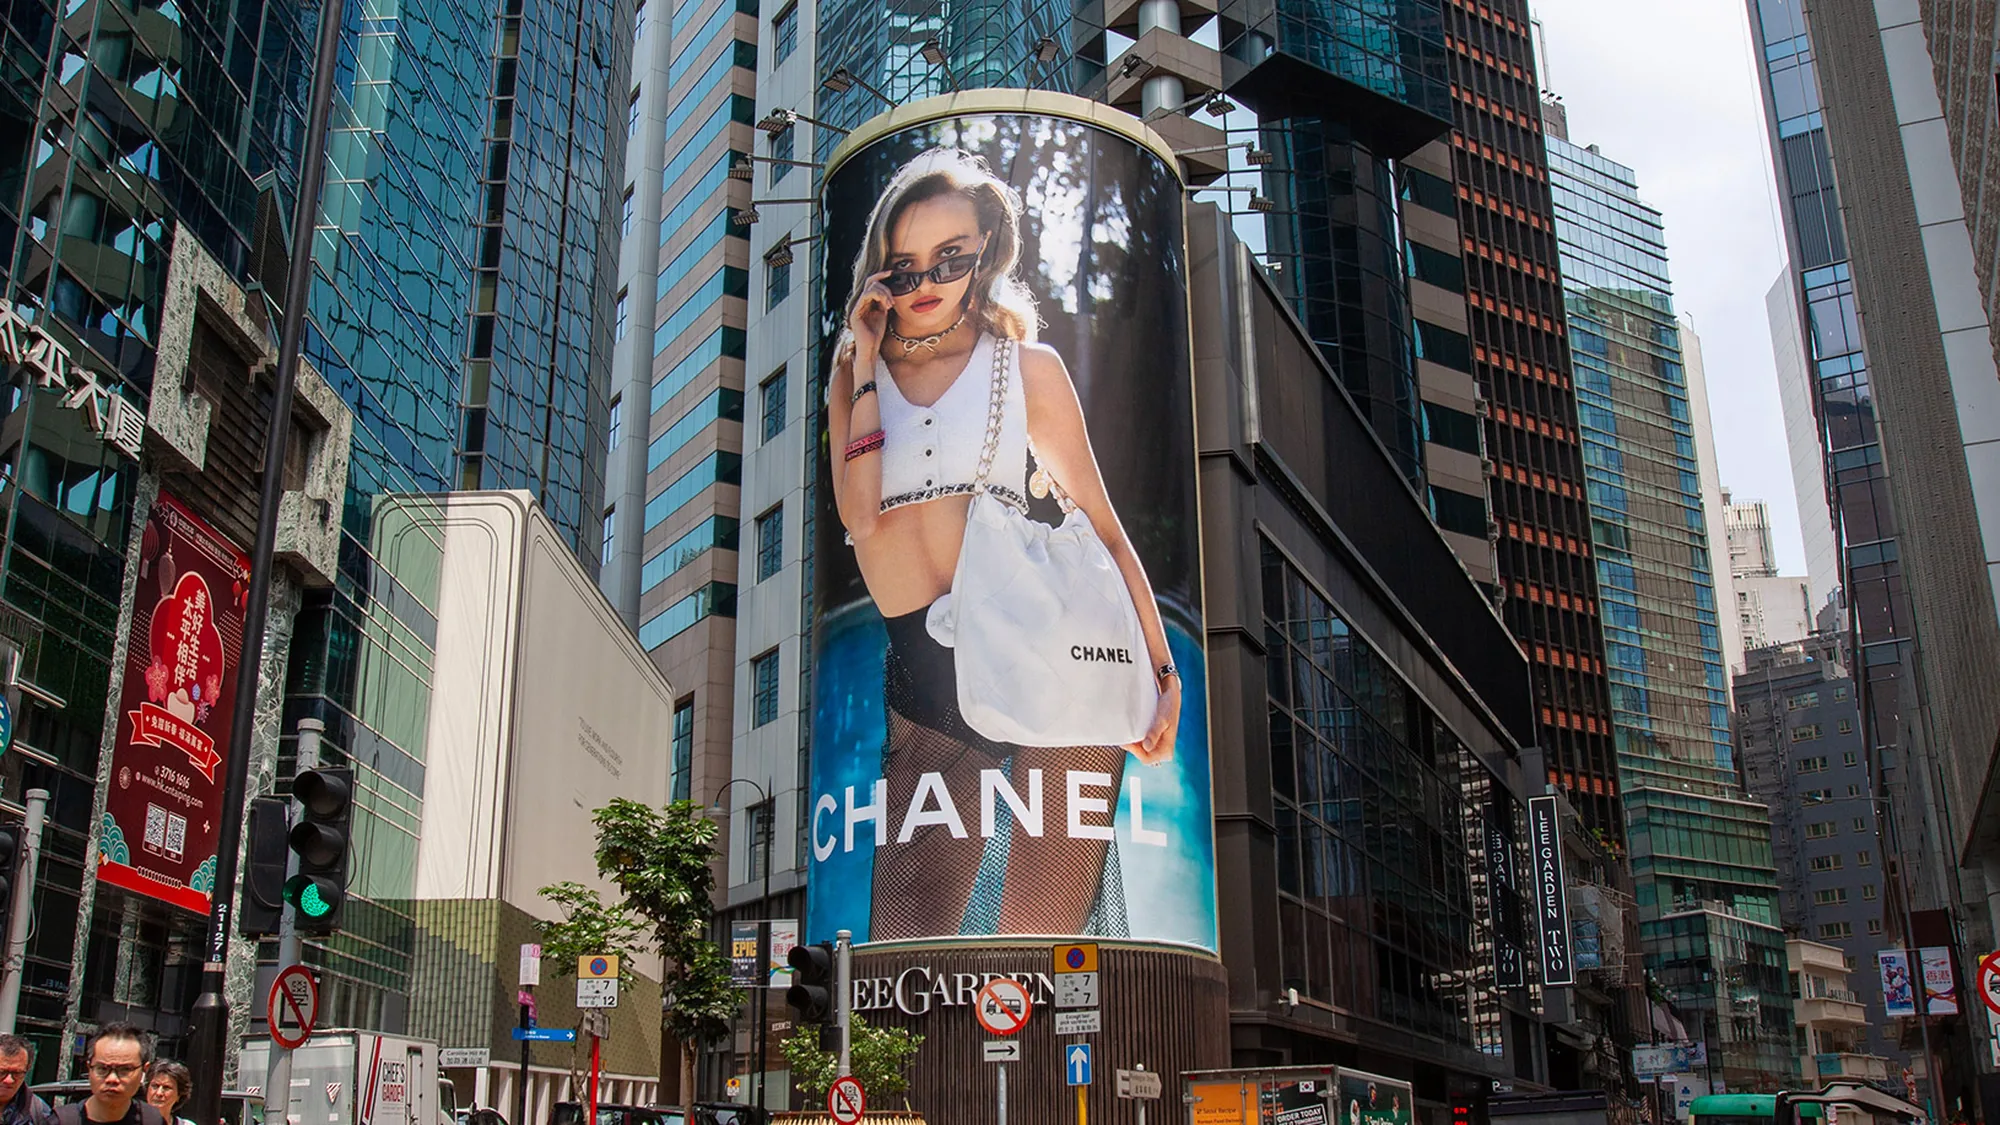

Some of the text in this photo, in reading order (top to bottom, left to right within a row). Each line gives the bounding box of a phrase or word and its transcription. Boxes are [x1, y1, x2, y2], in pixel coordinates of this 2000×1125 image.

[174, 596, 194, 687] 太平相伴
[186, 589, 206, 681] 美好生活
[1070, 645, 1133, 664] CHANEL
[812, 769, 1168, 862] CHANEL
[1539, 810, 1564, 972] LEE GARDEN TWO
[214, 903, 228, 951] 21127
[733, 941, 757, 958] EPIC
[603, 980, 610, 990] 7
[1083, 974, 1091, 986] 7
[602, 995, 615, 1006] 12
[1083, 992, 1091, 1004] 7
[1277, 1111, 1300, 1123] ORDER
[1300, 1107, 1322, 1118] TODAY
